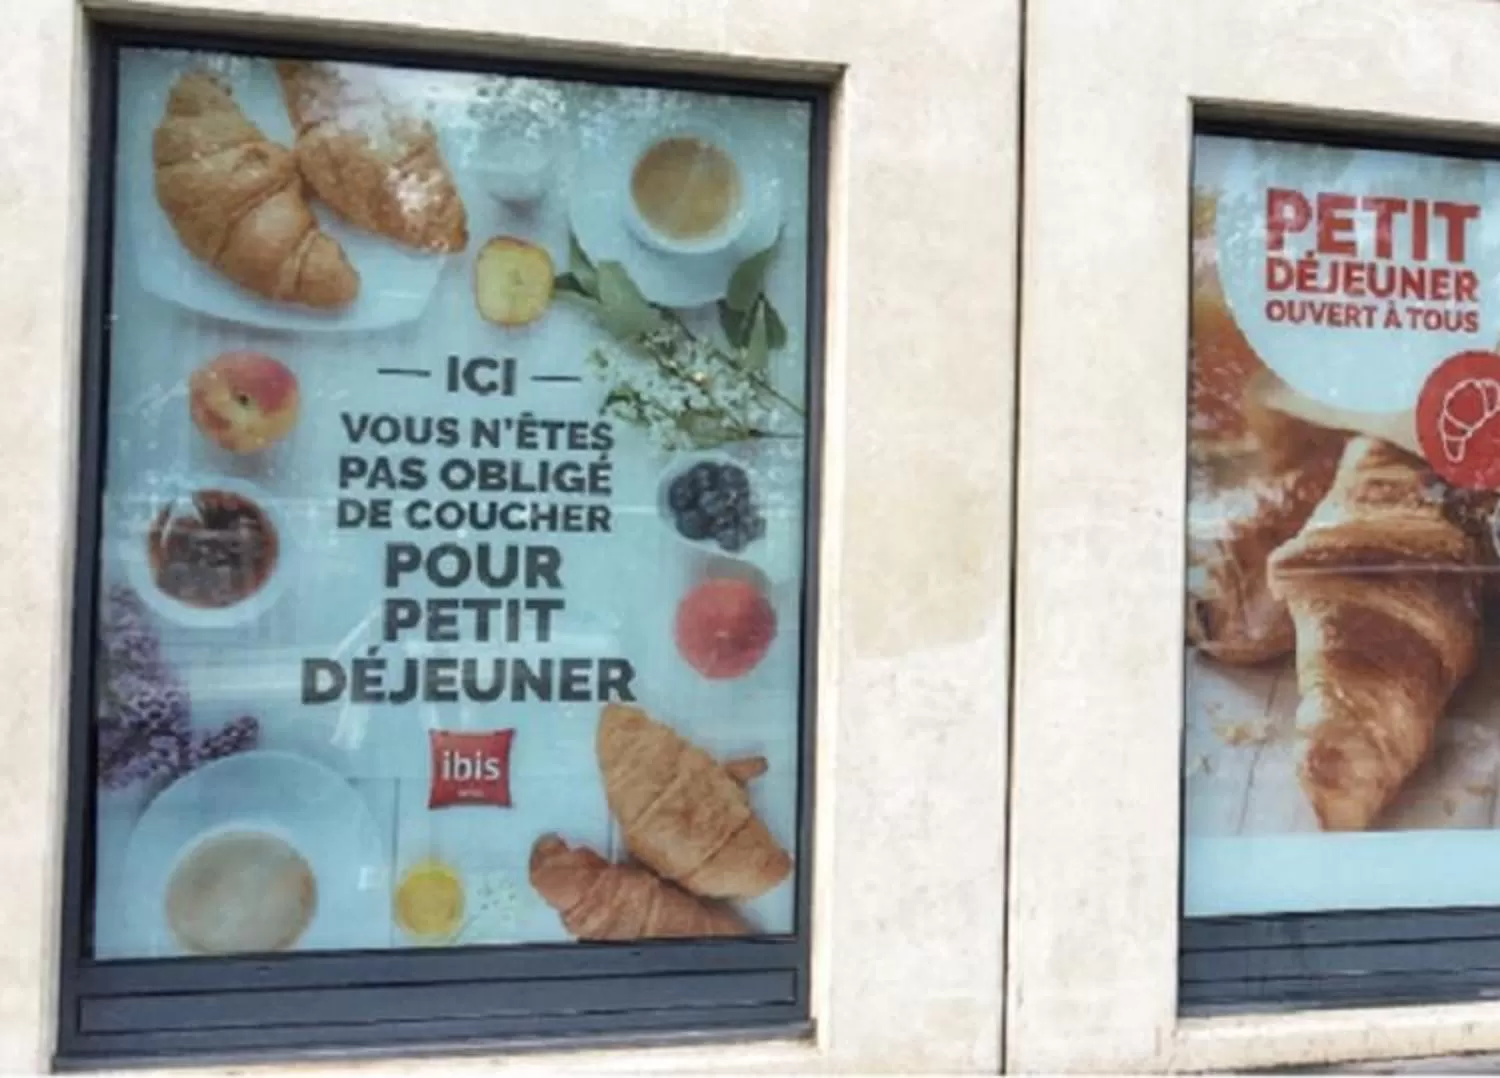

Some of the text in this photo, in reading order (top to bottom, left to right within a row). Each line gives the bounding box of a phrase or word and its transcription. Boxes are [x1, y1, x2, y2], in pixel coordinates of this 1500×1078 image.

[1265, 187, 1481, 264] PETIT
[1265, 252, 1480, 303] DÉJEUNER
[1265, 300, 1480, 333] OUVERT À TOUS
[446, 355, 517, 396] ICI
[340, 411, 615, 451] VOUS N'ÊTES
[338, 454, 613, 496] PAS OBLIGÉ
[337, 498, 612, 532] DE COUCHER
[384, 542, 564, 589] POUR
[383, 597, 566, 642] PETIT
[301, 645, 637, 704] DÉJEUNER
[443, 749, 501, 781] ibis
